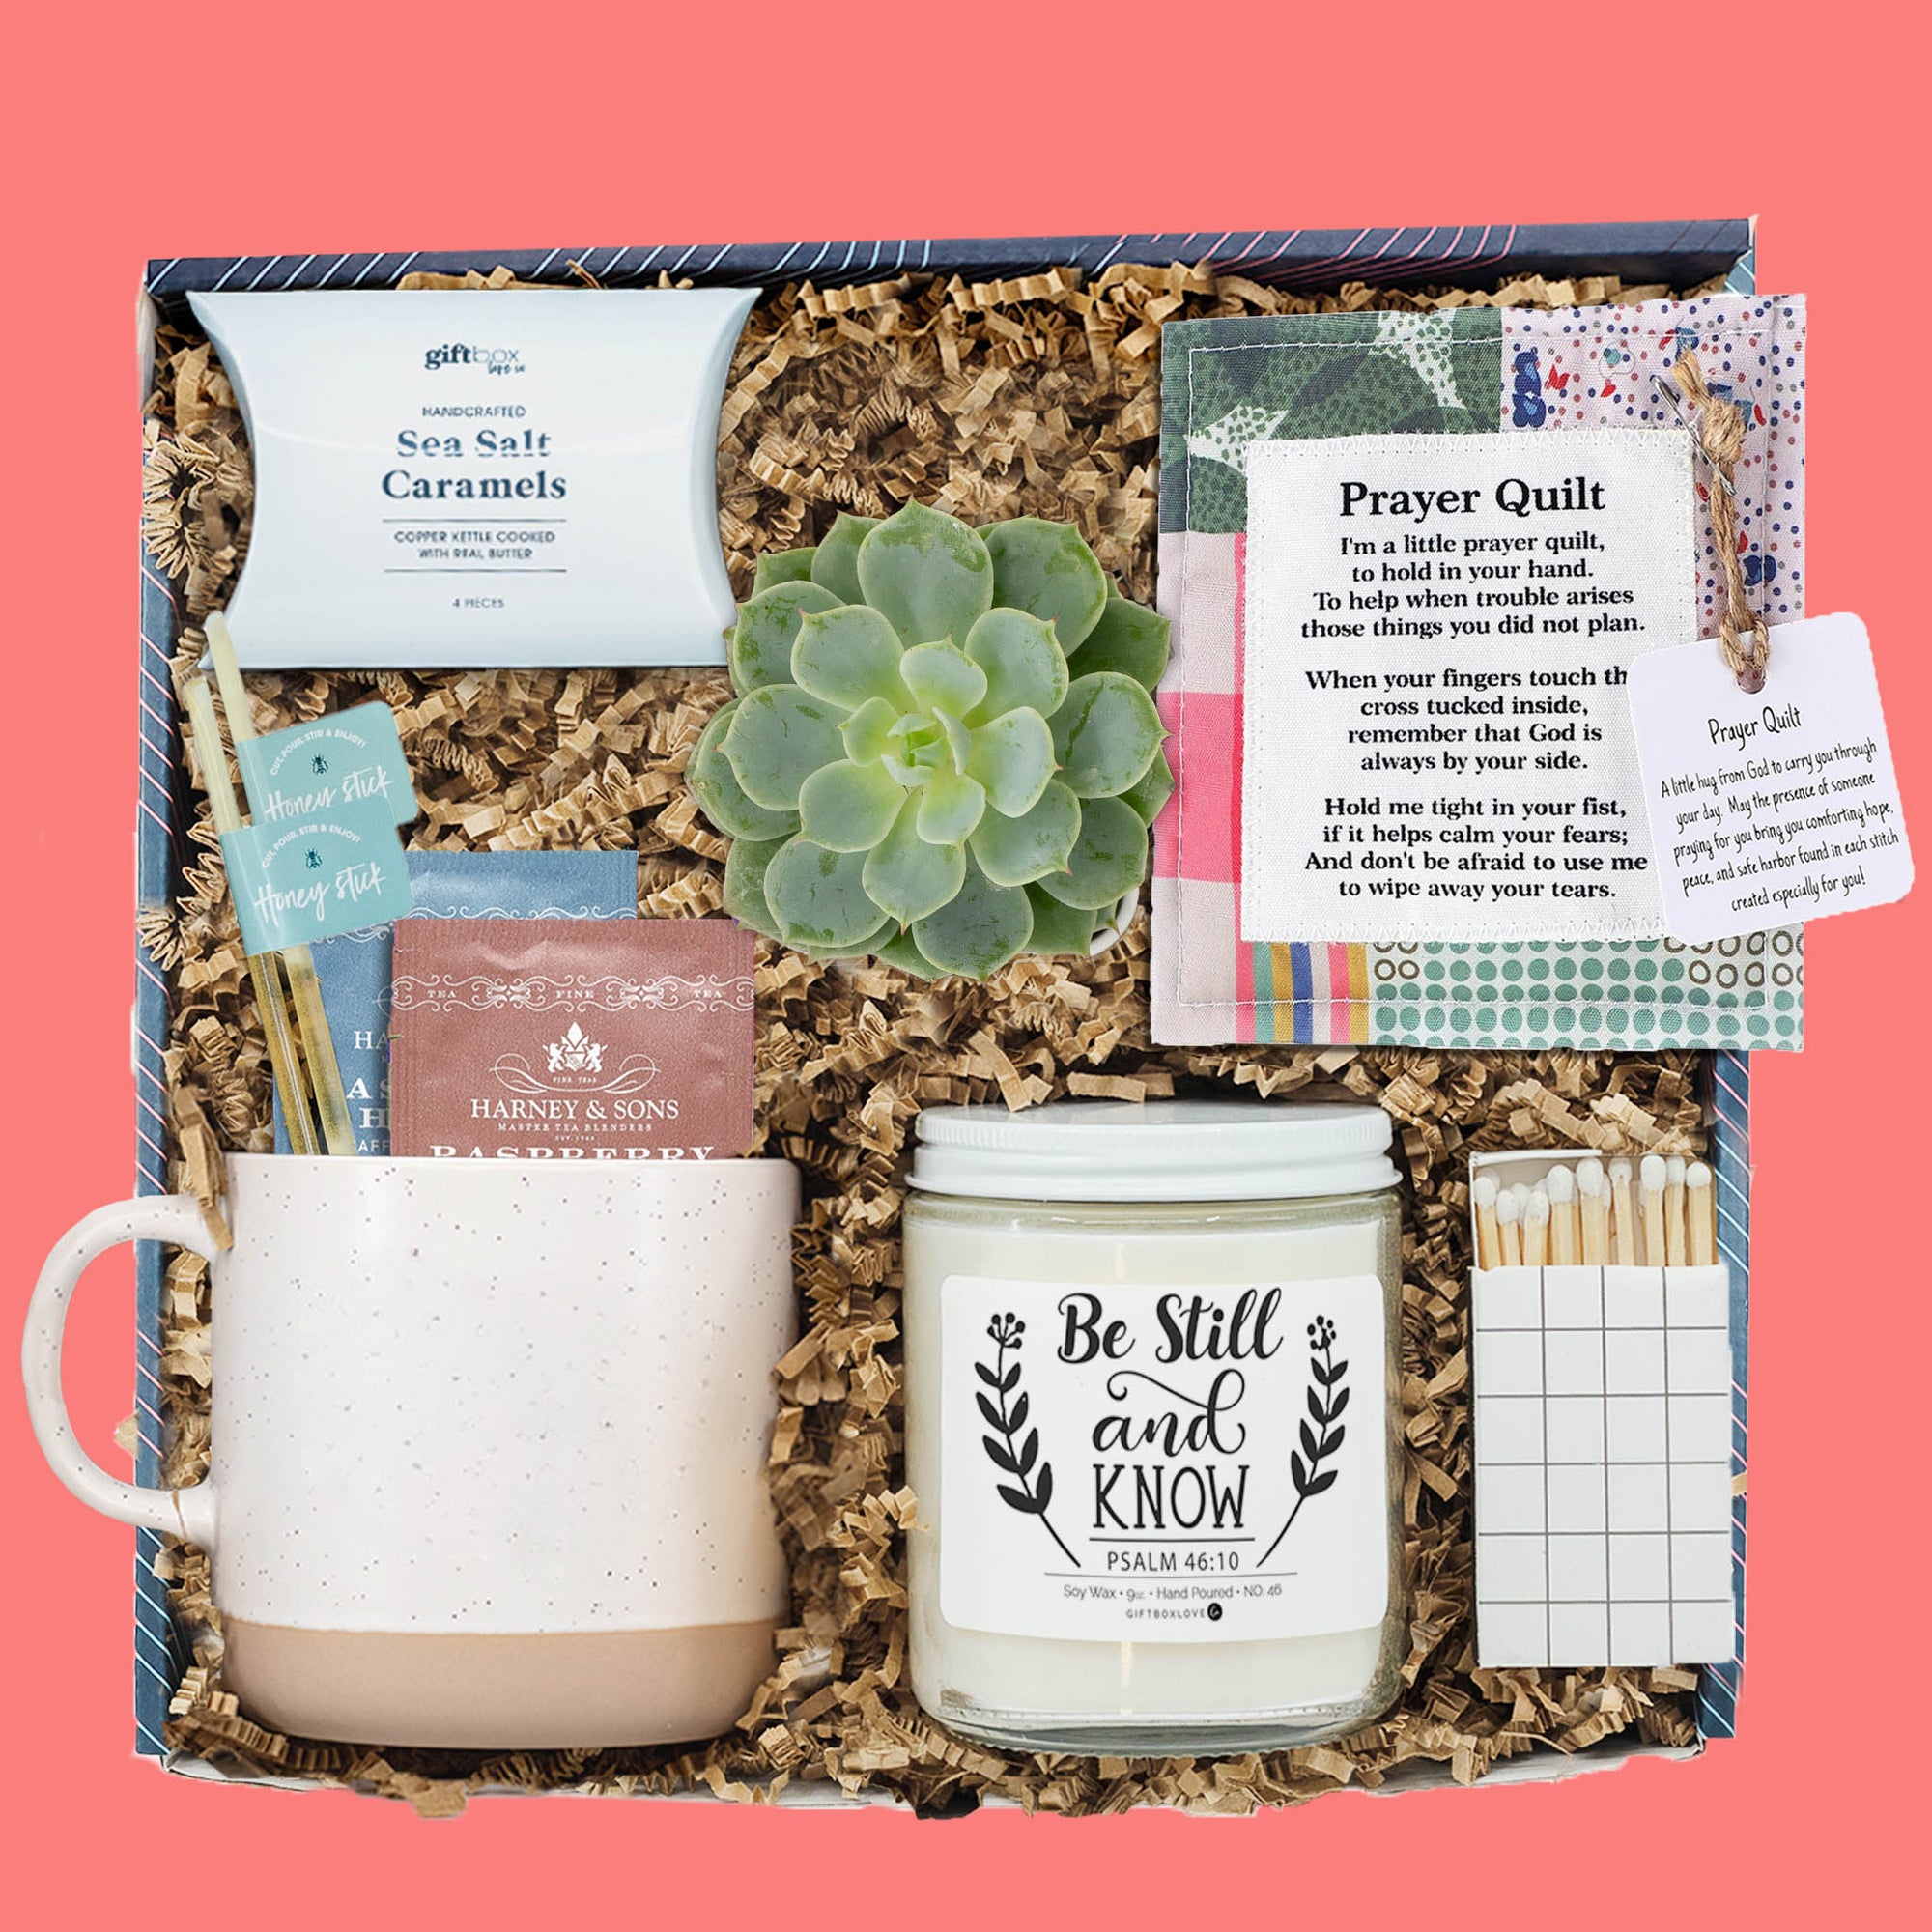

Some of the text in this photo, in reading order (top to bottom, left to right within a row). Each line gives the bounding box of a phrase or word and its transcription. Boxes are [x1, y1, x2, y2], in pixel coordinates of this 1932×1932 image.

[424, 343, 520, 370] giftbox
[422, 405, 526, 418] HANDCRAFTED
[398, 429, 551, 458] Sea Salt
[382, 469, 566, 499] Caramels
[1340, 476, 1605, 524] Prayer Quilt
[394, 530, 555, 543] COPPER KETTLE COOKED
[1341, 530, 1605, 557] I'm a little prayer quilt,
[419, 548, 532, 559] WITH REAL BUTTER
[1352, 558, 1593, 584] to hold in your hand.
[452, 598, 504, 608] 4 PIECES
[1313, 586, 1634, 613] To help when trouble arises
[1301, 612, 1645, 639] those things you did not plan.
[1305, 666, 1627, 693] When your fingers touch th
[1360, 695, 1588, 716] cross tucked inside,
[1349, 723, 1602, 743] remember that God is
[1707, 703, 1802, 752] Prayer Quilt
[1361, 750, 1588, 775] always by your side.
[1662, 737, 1877, 798] A little hug from God to carry you through
[341, 765, 395, 803] stick
[1325, 797, 1626, 821] Hold me tight in your fist,
[1676, 774, 1875, 835] your day. May the presence of someone
[1323, 824, 1628, 848] if it helps calm your fears;
[1673, 801, 1893, 867] praying for you bring you comforting hope,
[1305, 850, 1648, 871] And don't be afraid to use me
[1682, 828, 1899, 897] peace, and safe harbor found in each stitch
[253, 861, 387, 928] Honey stick
[1339, 878, 1615, 902] to wipe away your tears.
[1731, 865, 1866, 911] created especially for you!
[427, 989, 724, 999] TEA FINE TEA
[470, 1098, 679, 1120] HARNEY & SONS
[497, 1122, 652, 1132] MASTER TEA BLENDERS
[1057, 1287, 1284, 1365] Be Still
[1092, 1368, 1246, 1458] and
[1092, 1463, 1250, 1530] KNOW
[1107, 1551, 1239, 1572] PSALM 46:10
[1064, 1585, 1087, 1600] Soy
[1089, 1586, 1116, 1599] Wax
[1157, 1588, 1188, 1599] Hand
[1192, 1586, 1234, 1599] Poured
[1267, 1584, 1282, 1596] 46
[1126, 1608, 1205, 1619] GIFTBOXLOVE
